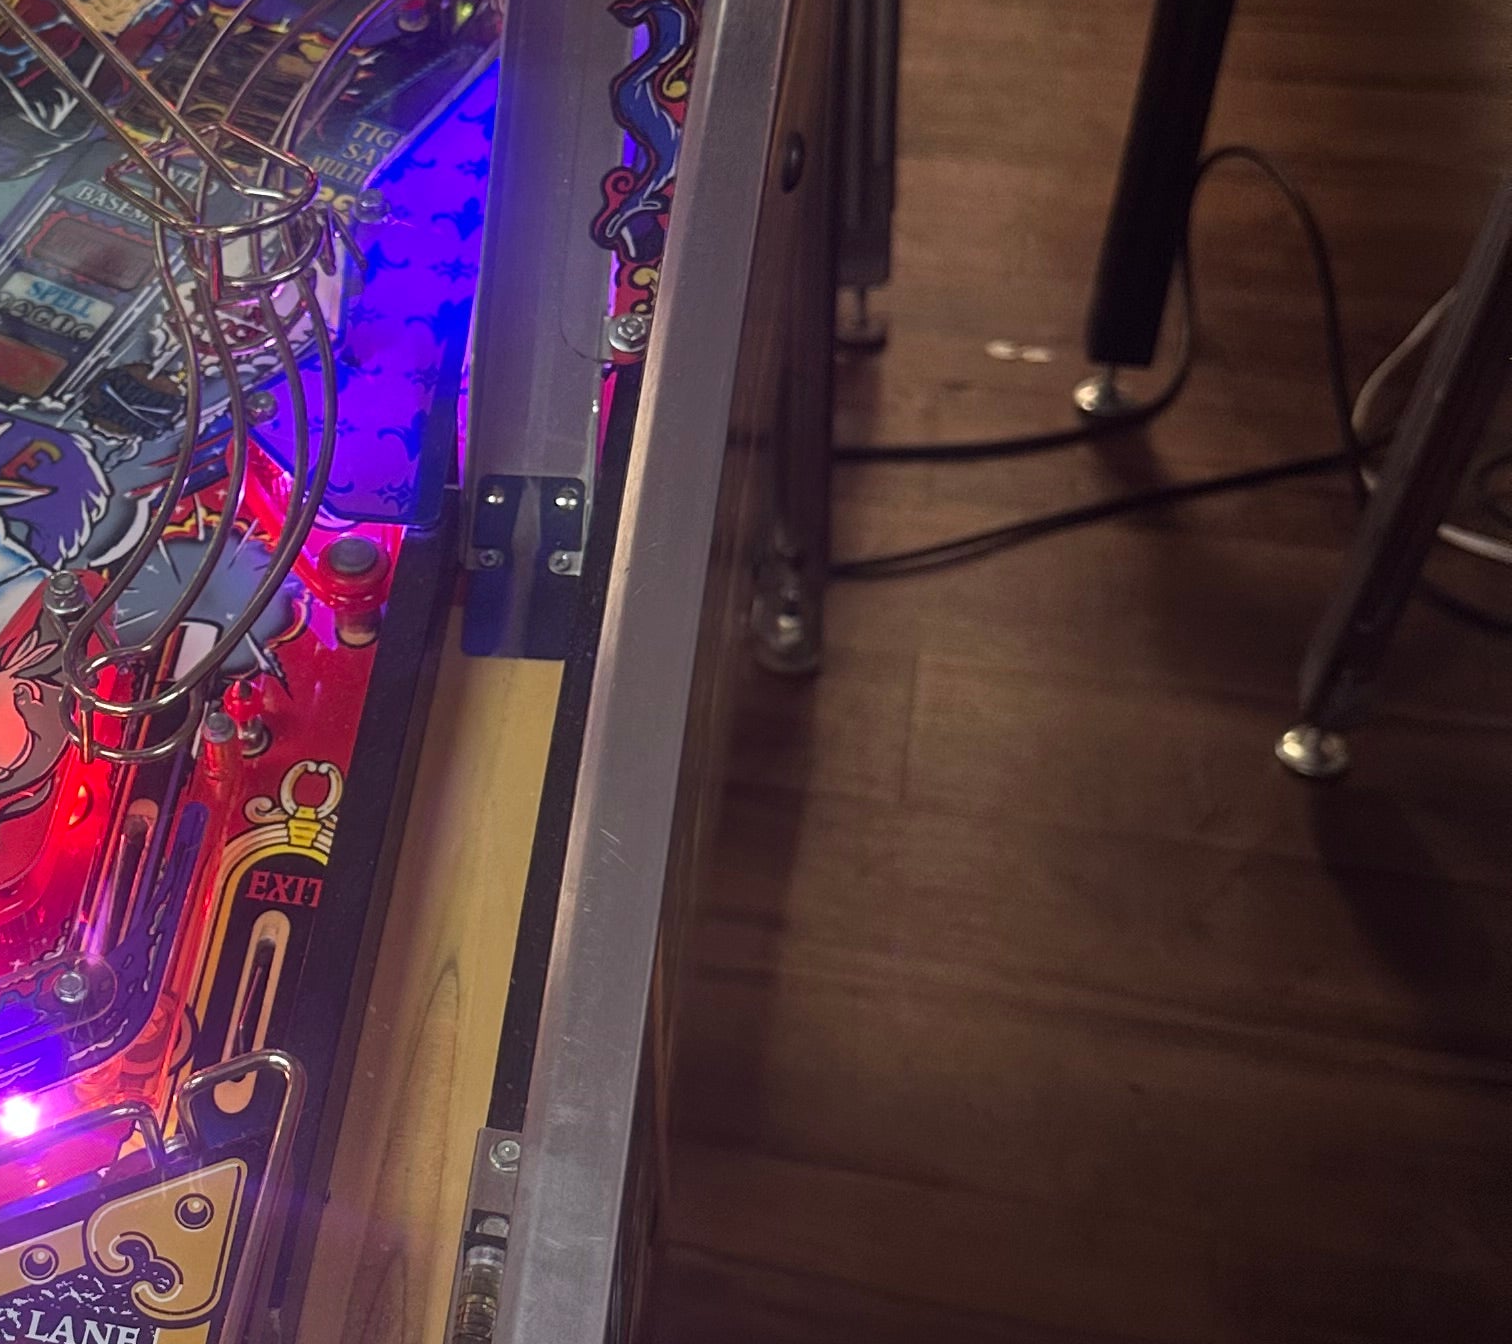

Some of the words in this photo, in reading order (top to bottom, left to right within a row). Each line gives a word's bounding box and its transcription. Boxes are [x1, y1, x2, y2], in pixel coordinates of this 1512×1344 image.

[352, 120, 401, 148] TIG
[342, 143, 381, 167] SA
[28, 279, 98, 319] SPELL
[245, 869, 324, 908] EXIT
